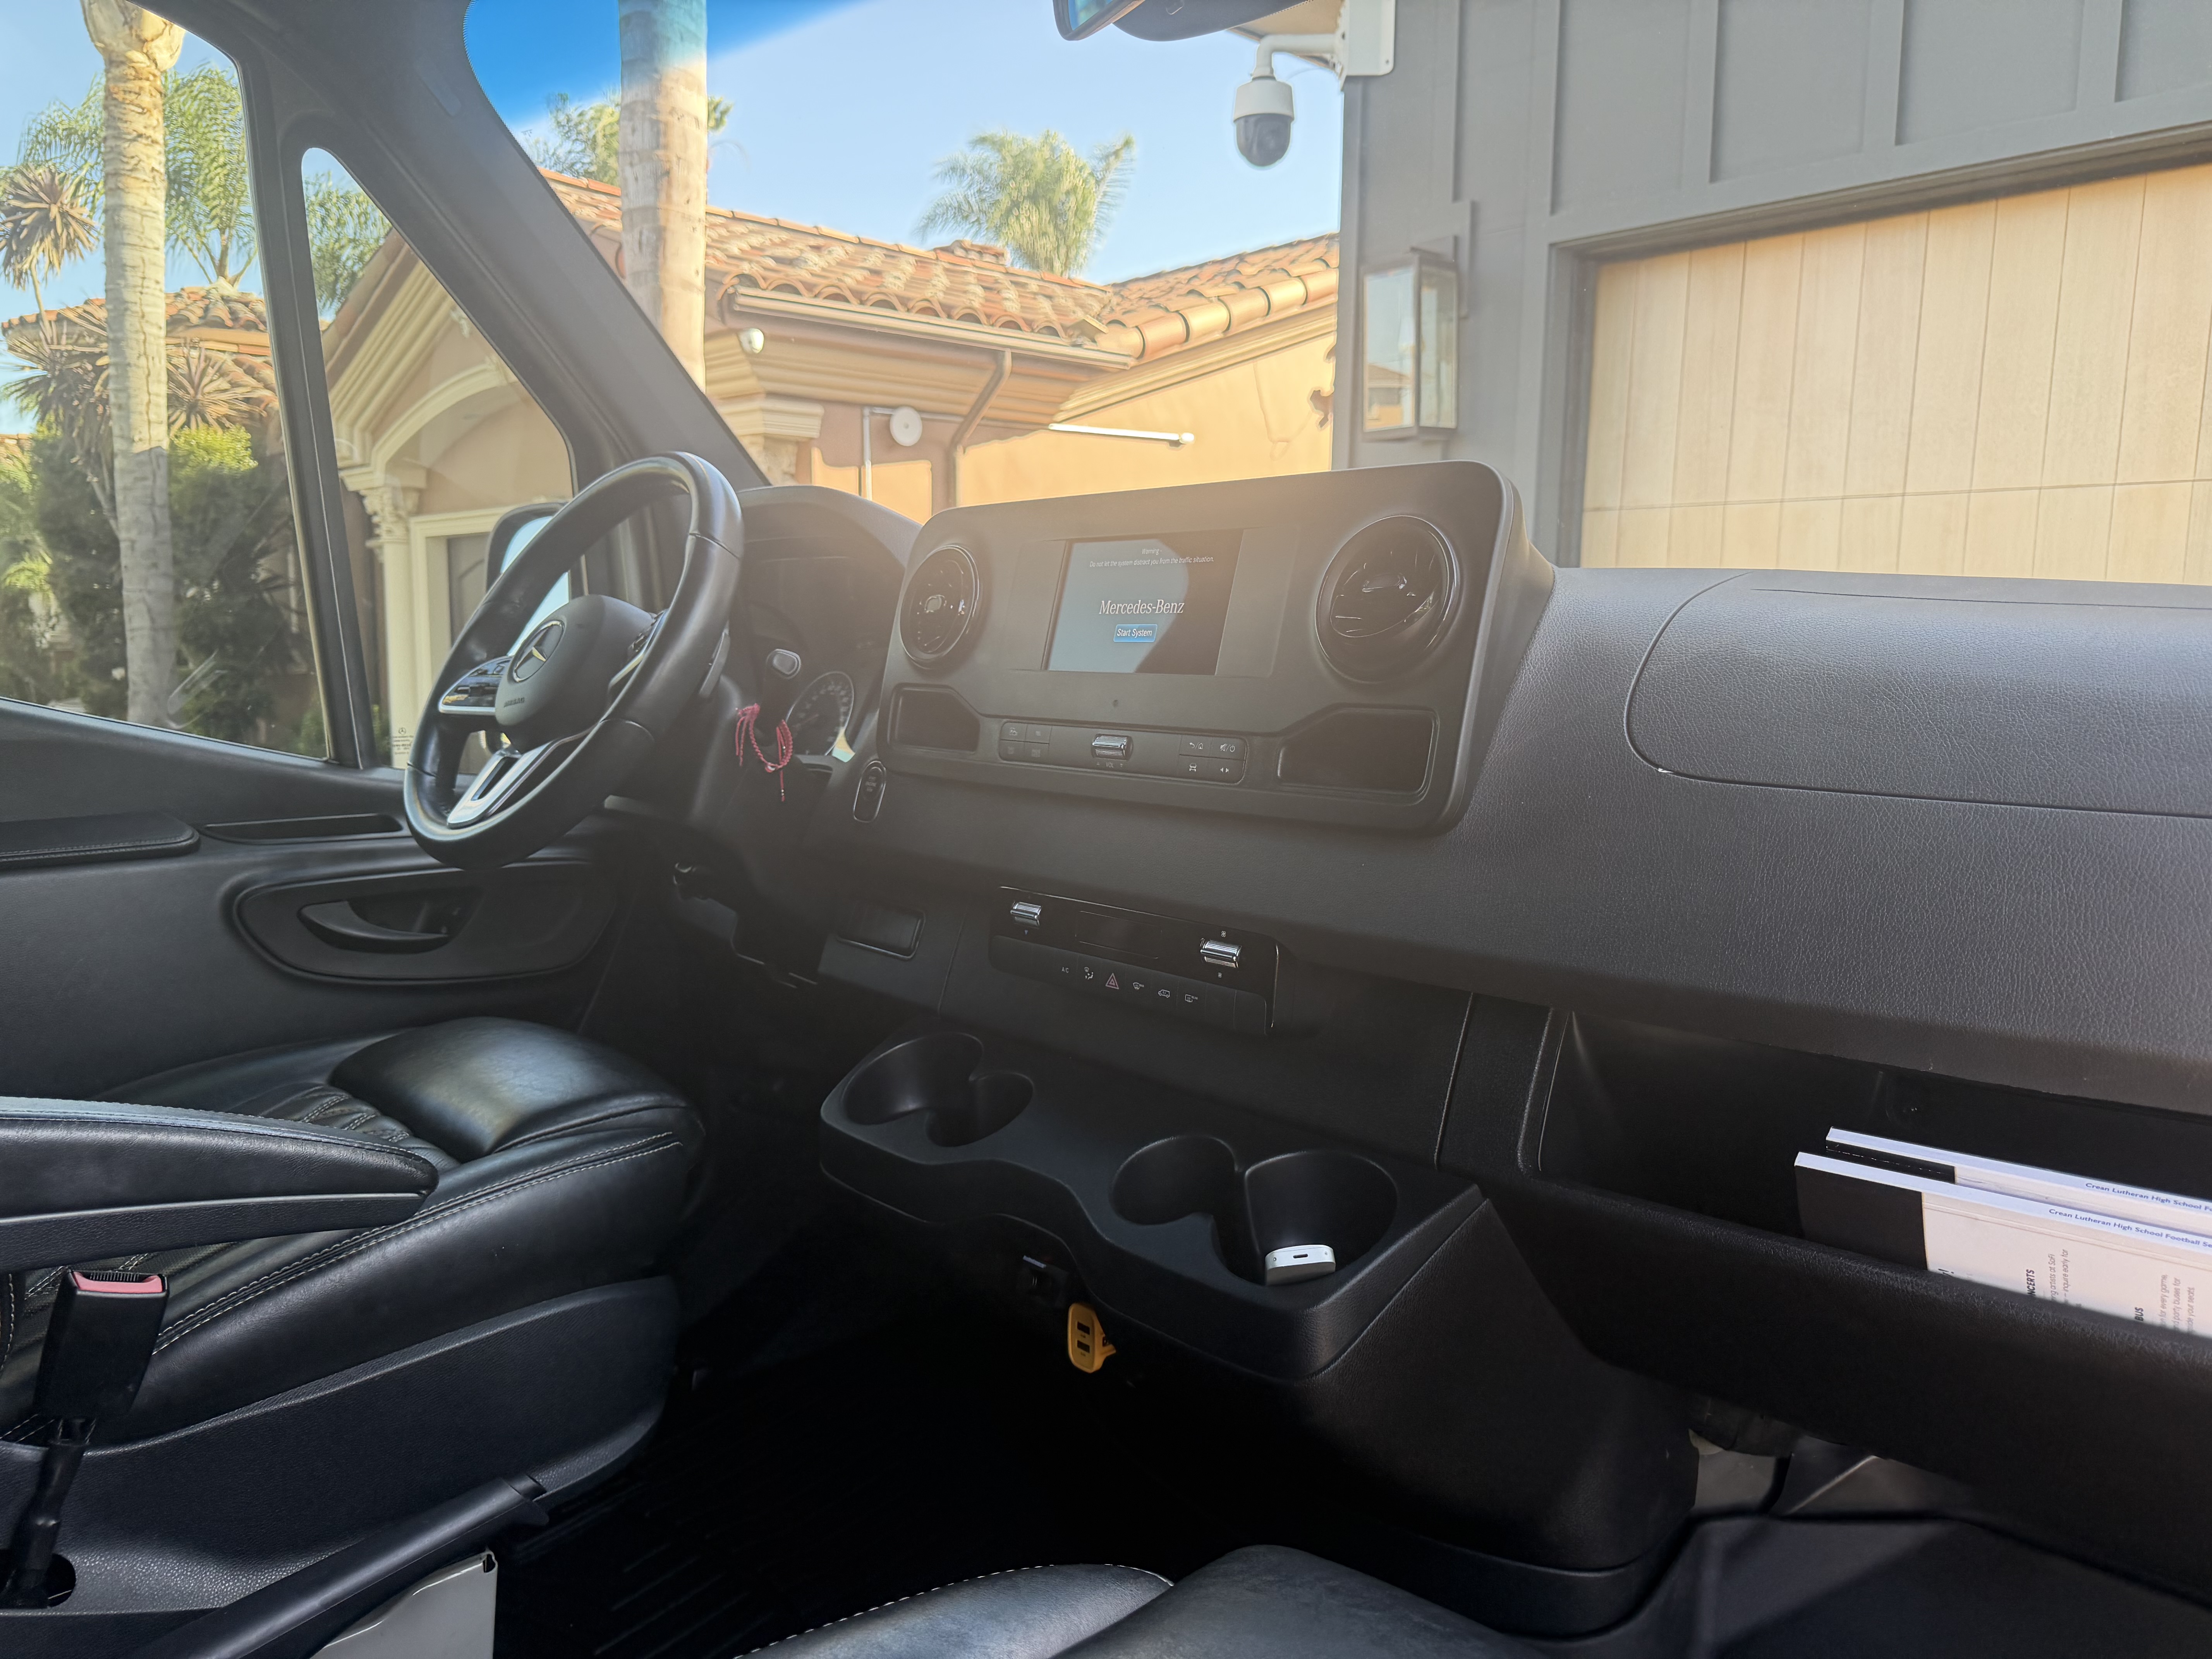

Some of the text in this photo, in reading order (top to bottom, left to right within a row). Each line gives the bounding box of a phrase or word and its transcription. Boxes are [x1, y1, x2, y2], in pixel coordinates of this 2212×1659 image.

[1099, 599, 1185, 614] Mercedes-Benz
[1117, 628, 1152, 638] Start System
[2085, 1183, 2110, 1192] Crean
[2112, 1187, 2148, 1199] Lutheran
[2151, 1195, 2171, 1204] High
[2173, 1199, 2202, 1210] School
[2049, 1209, 2072, 1218] Crean
[2075, 1214, 2111, 1226] Lutheran
[2113, 1222, 2132, 1231] High
[2135, 1227, 2163, 1237] School
[2165, 1233, 2200, 1245] Football
[2060, 1249, 2069, 1258] for
[2060, 1258, 2071, 1273] early
[2160, 1293, 2169, 1309] every
[2135, 1307, 2144, 1321] BUS
[2173, 1305, 2183, 1321] party
